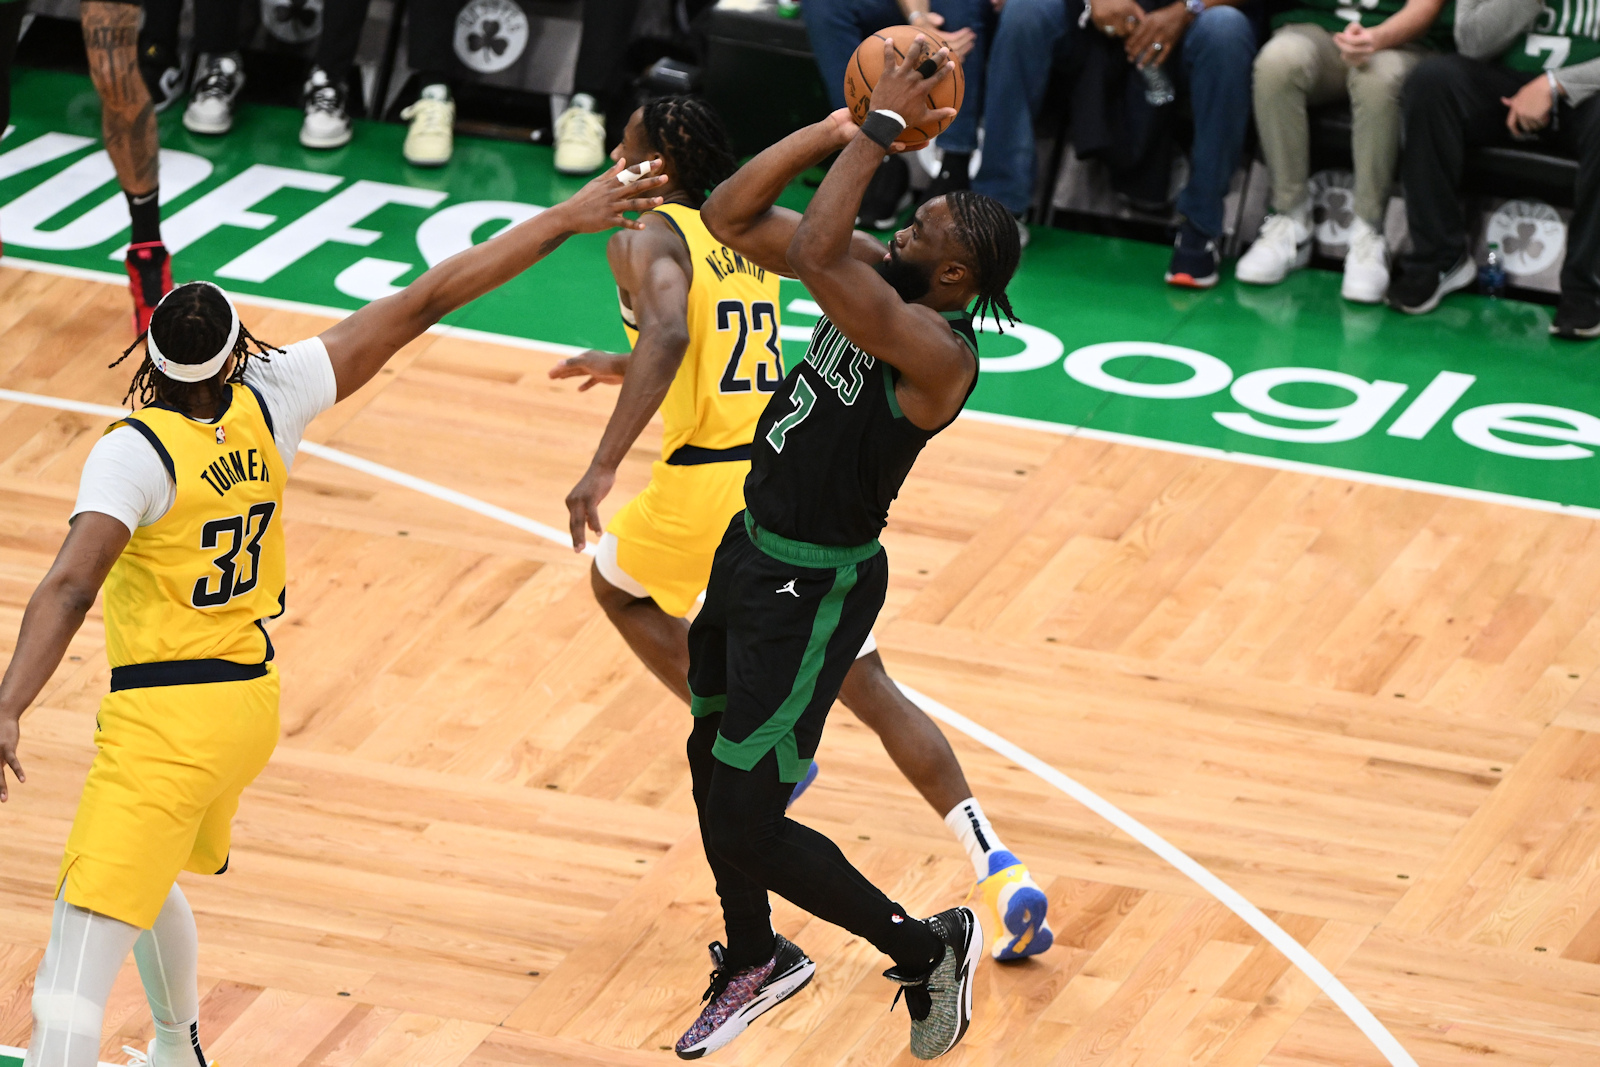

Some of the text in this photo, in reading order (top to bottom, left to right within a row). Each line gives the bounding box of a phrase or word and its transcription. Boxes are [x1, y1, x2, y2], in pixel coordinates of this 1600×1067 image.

[1524, 32, 1572, 70] 7
[716, 299, 785, 395] 23
[766, 373, 818, 455] 7
[191, 501, 277, 608] 33
